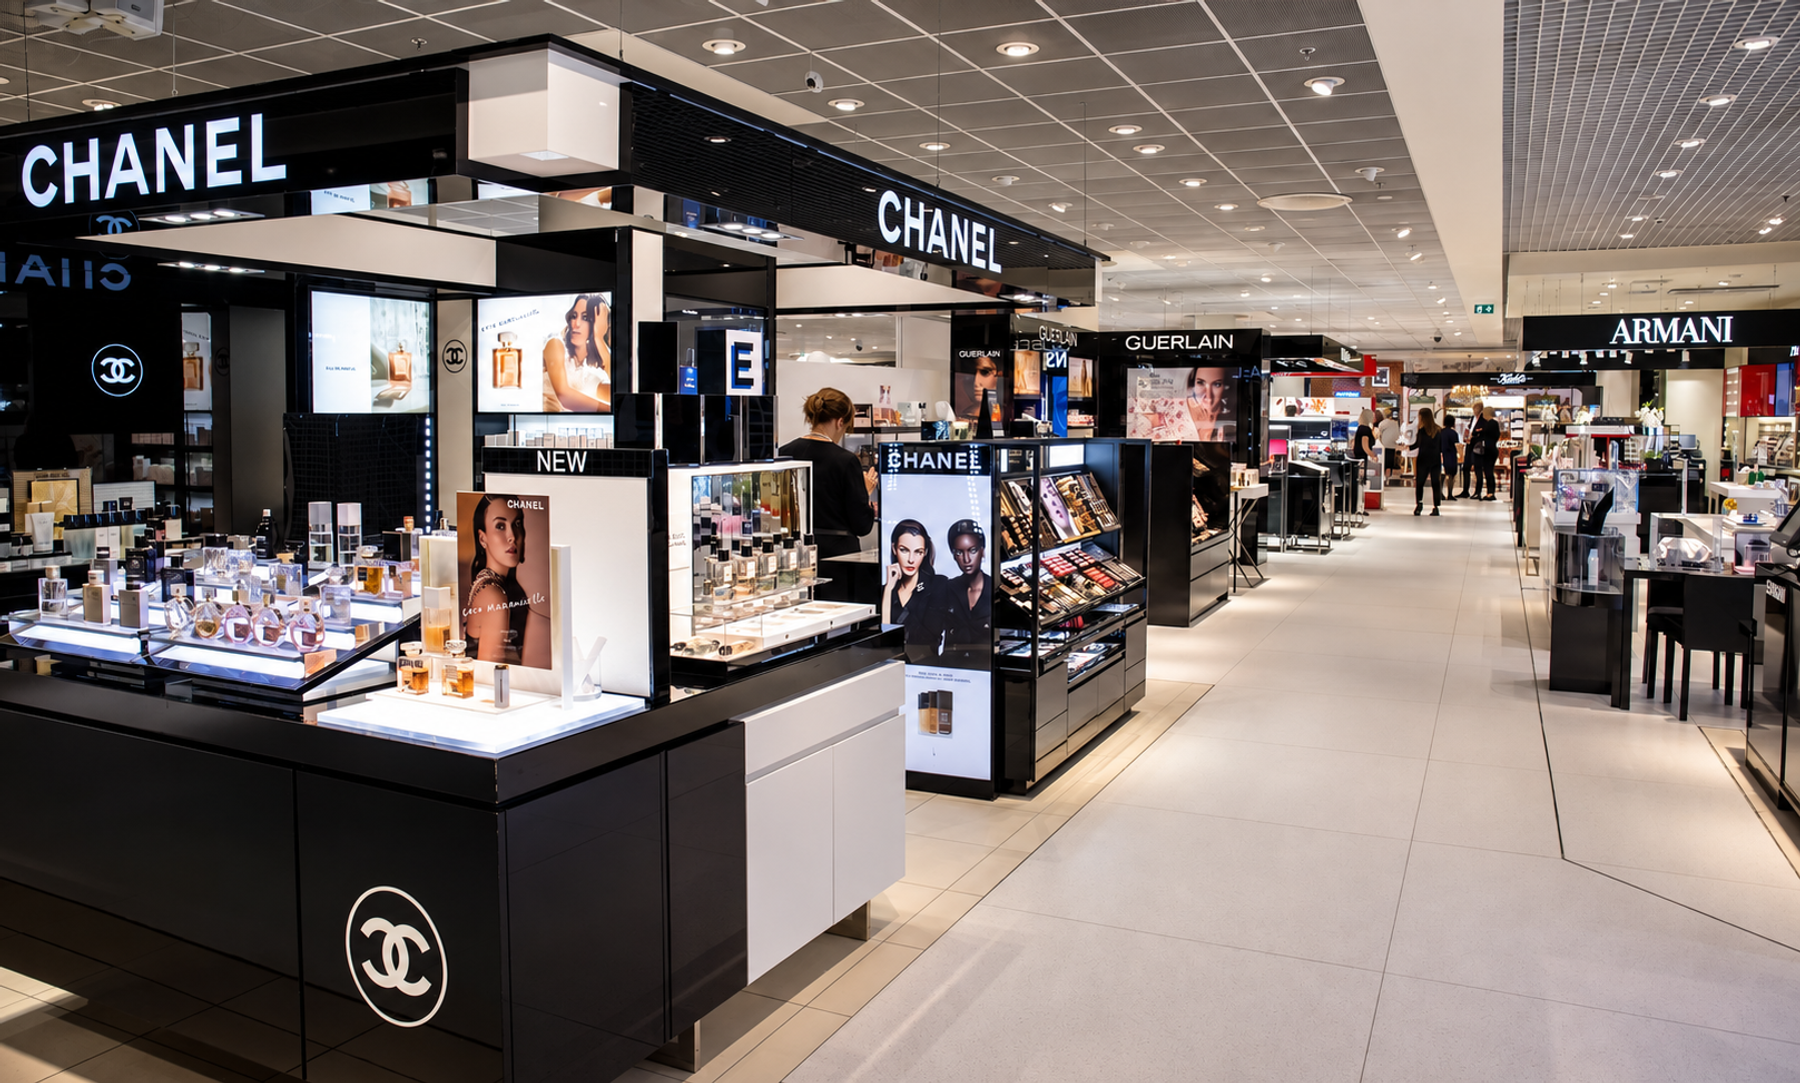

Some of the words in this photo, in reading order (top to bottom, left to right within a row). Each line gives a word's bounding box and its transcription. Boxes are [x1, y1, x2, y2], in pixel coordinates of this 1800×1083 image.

[21, 113, 287, 208] CHANEL
[877, 190, 1002, 274] CHANEL
[1039, 325, 1078, 347] GUERLAIN
[1609, 315, 1734, 345] ARMANI
[1125, 334, 1234, 351] GUERLAIN
[959, 350, 1001, 358] GUERLAIN
[537, 449, 588, 474] NEW
[888, 451, 982, 470] CHANEL
[507, 499, 545, 510] CHANEL
